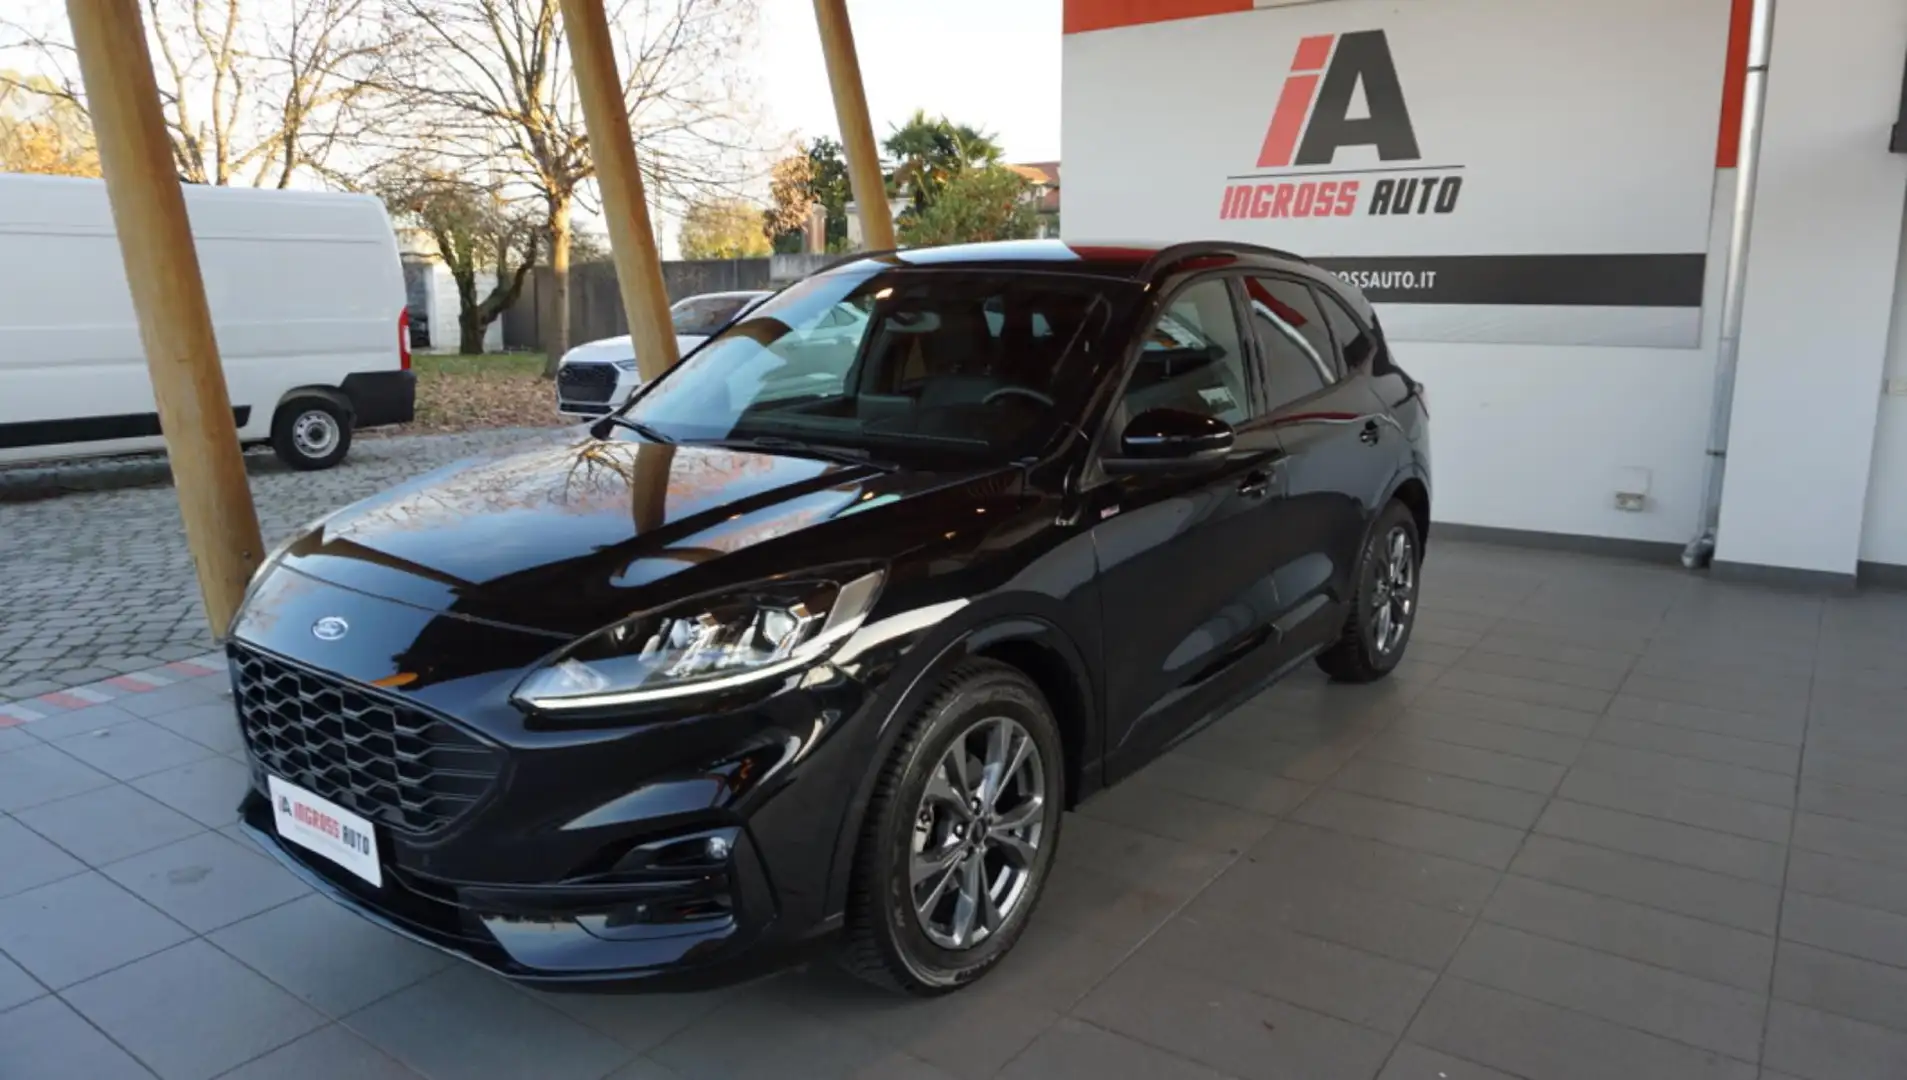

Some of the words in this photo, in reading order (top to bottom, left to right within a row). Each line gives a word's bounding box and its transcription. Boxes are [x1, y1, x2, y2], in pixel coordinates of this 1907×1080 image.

[1220, 181, 1360, 219] INGROSS
[1368, 176, 1463, 215] AUTO
[294, 802, 340, 839] INGROSS
[343, 825, 370, 855] AUTO
